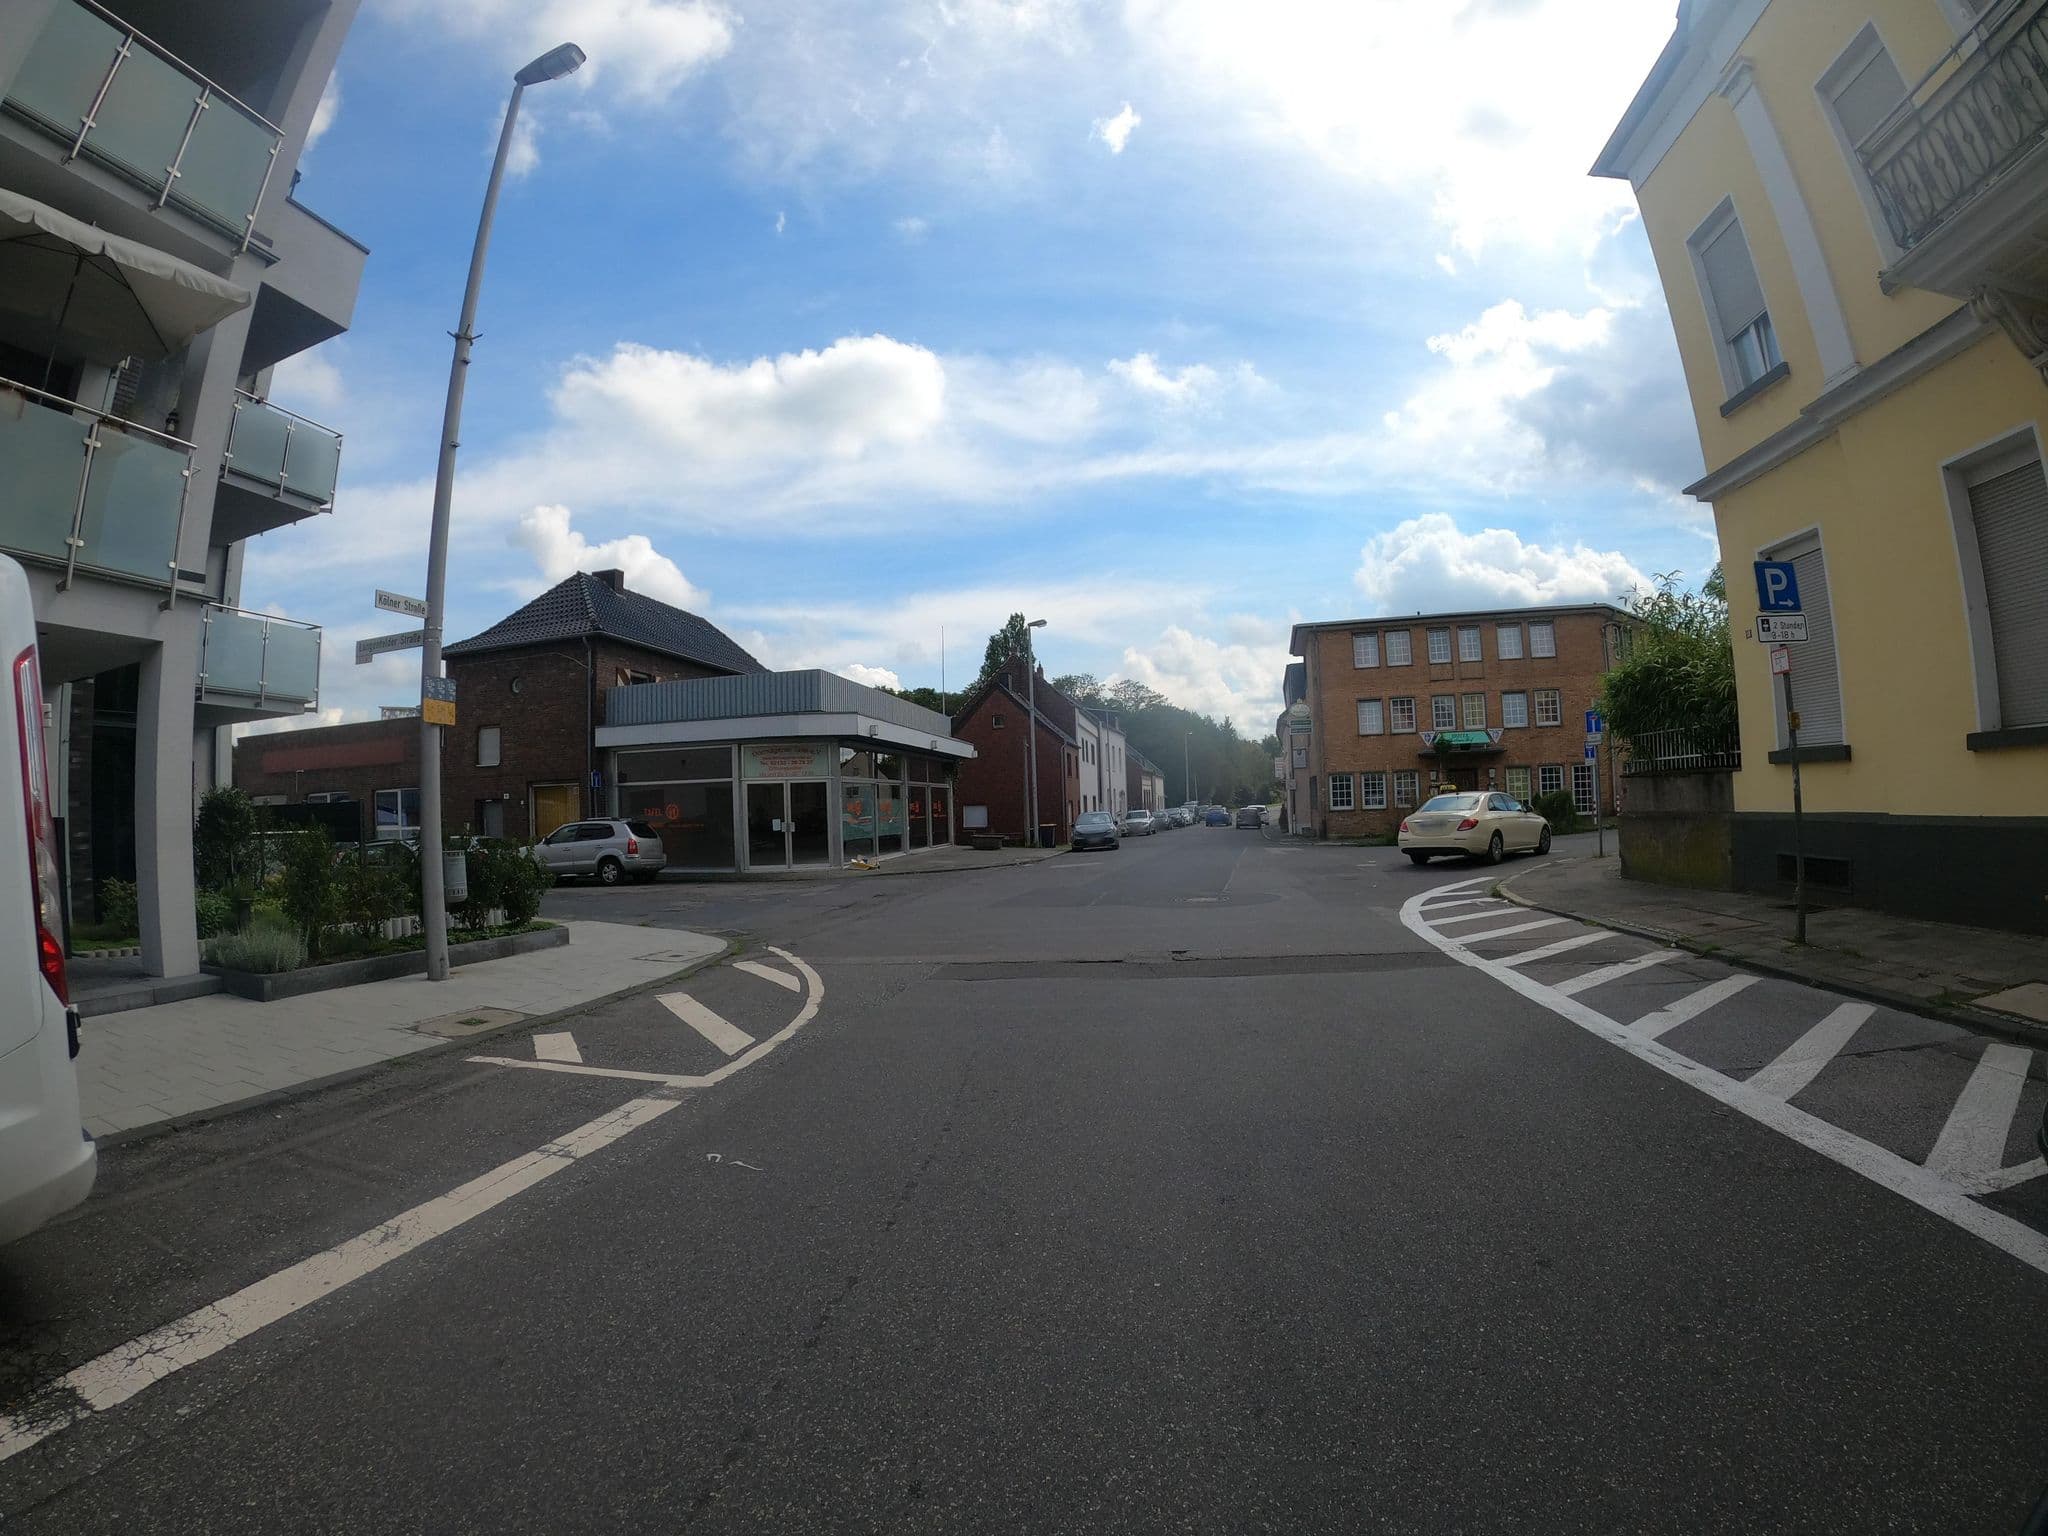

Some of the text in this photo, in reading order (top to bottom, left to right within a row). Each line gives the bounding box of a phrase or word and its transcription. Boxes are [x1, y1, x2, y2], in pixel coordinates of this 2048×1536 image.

[1764, 568, 1788, 605] P
[378, 593, 426, 615] Kölner Straße
[1780, 621, 1804, 631] Stunden
[400, 632, 422, 646] Straße
